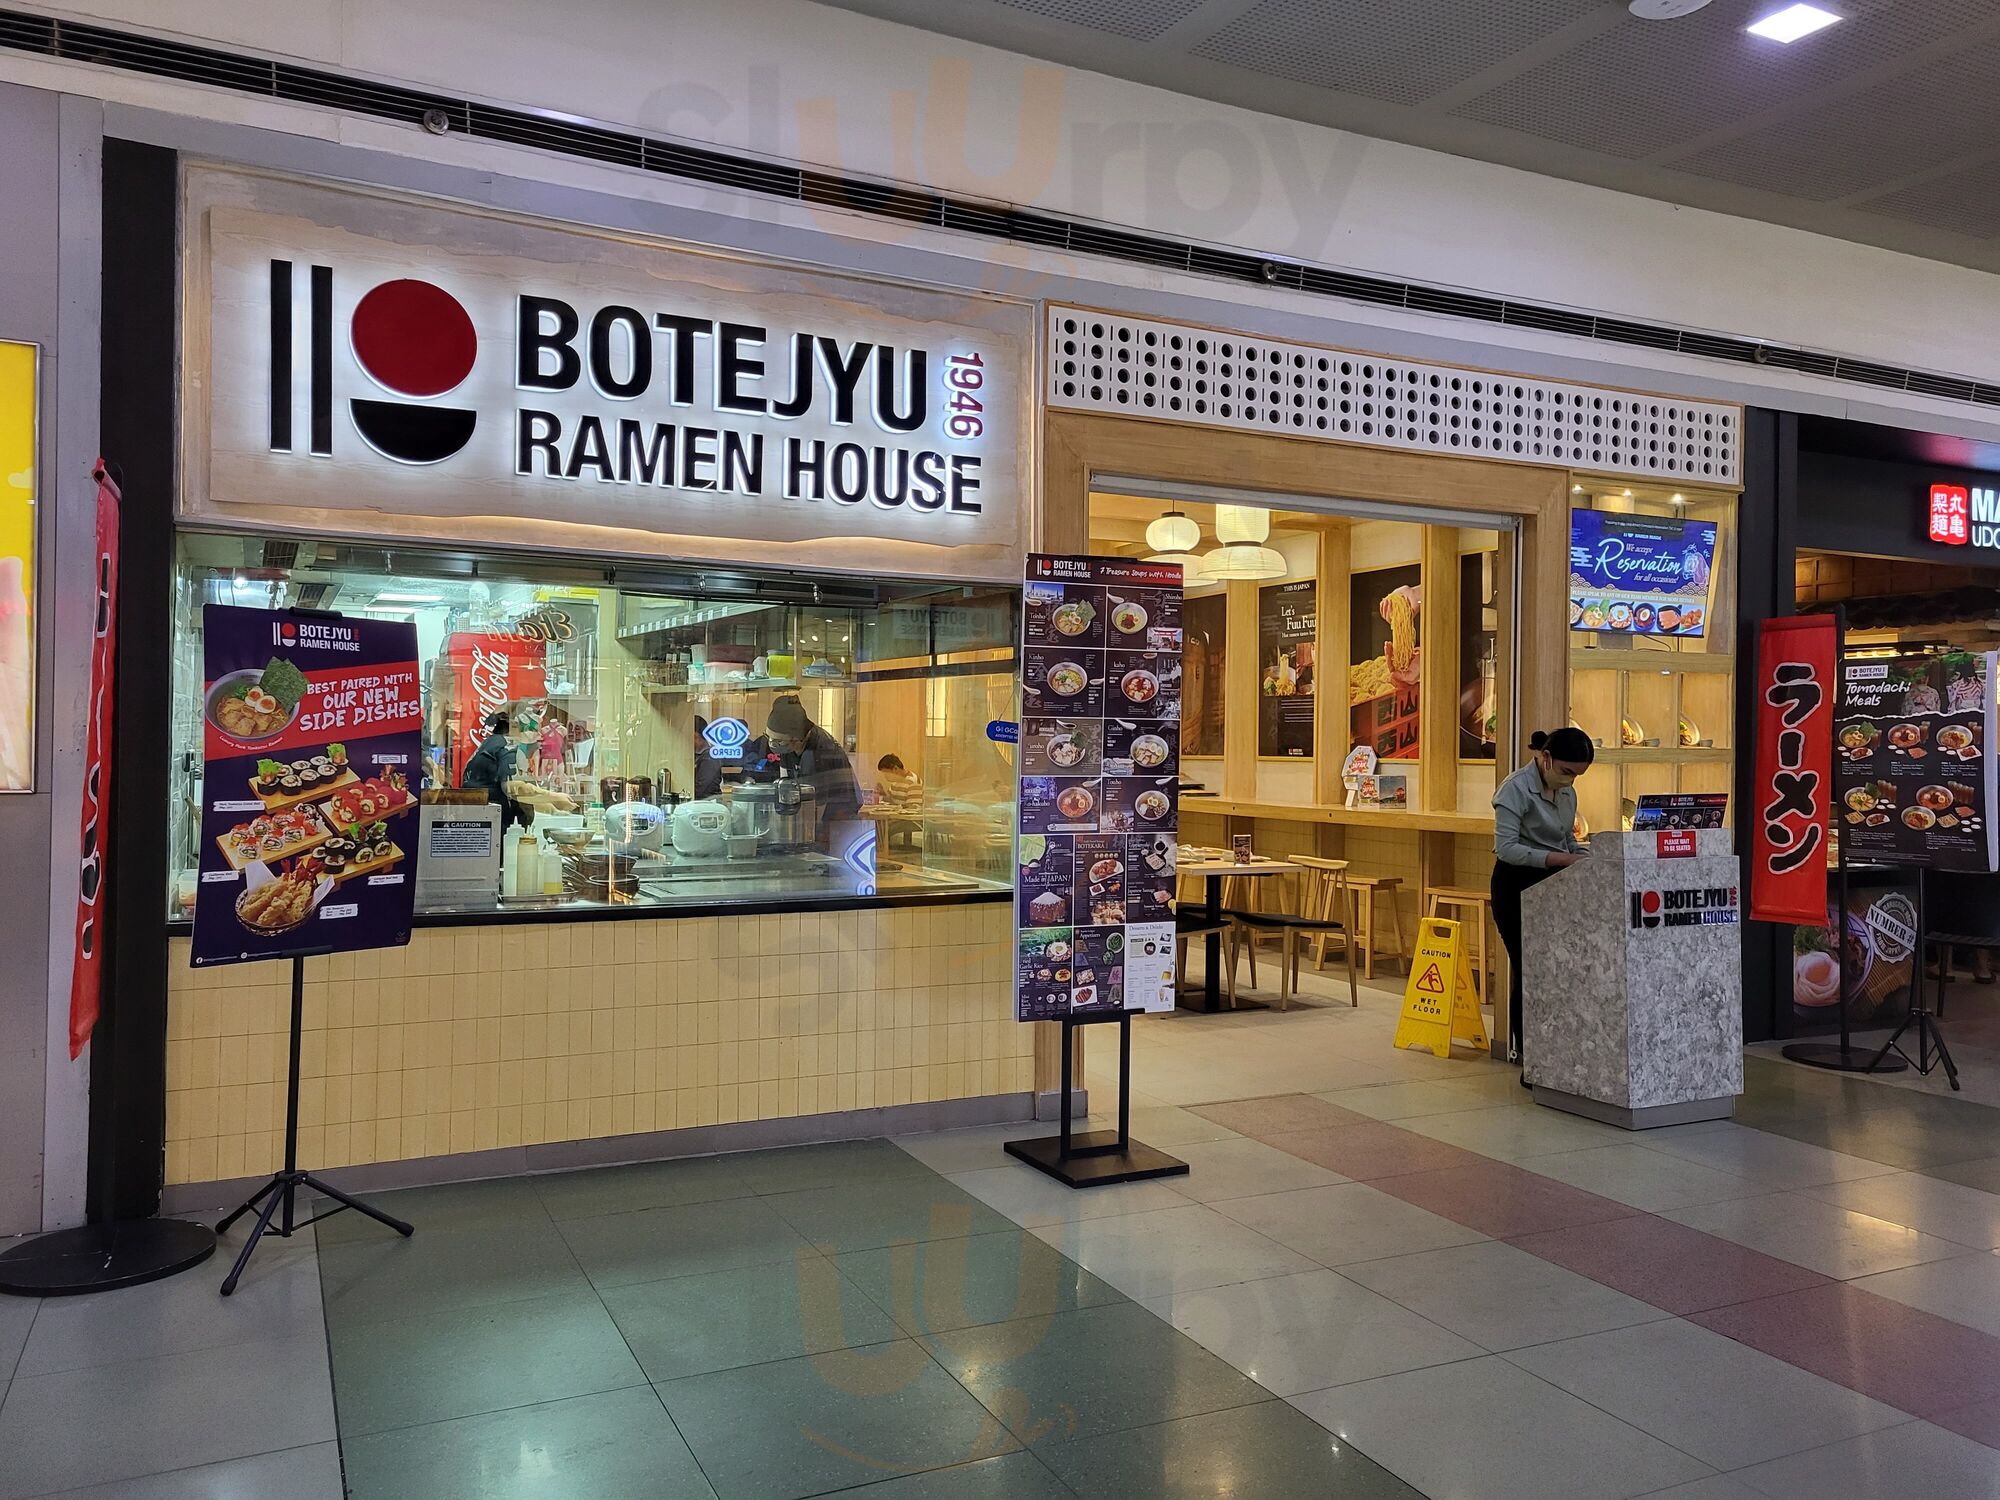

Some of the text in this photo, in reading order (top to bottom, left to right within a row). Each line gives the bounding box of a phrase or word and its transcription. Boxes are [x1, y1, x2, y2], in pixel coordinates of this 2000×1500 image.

[516, 294, 928, 433] BOTEJYU
[944, 352, 985, 440] 1946
[516, 408, 983, 515] RAMEN HOUSE
[1053, 560, 1087, 571] BOTEJYU
[1594, 538, 1683, 580] Reservation
[1053, 569, 1073, 577] RAMEN
[1106, 567, 1130, 576] Treasure
[1131, 569, 1148, 578] Soups
[1149, 569, 1164, 578] with
[1281, 604, 1295, 617] Let's
[1286, 617, 1301, 630] Fuu
[299, 624, 352, 641] BOTEJYU
[300, 638, 361, 652] RAMEN HOUSE
[307, 672, 413, 695] BEST PAIRED WITH
[1845, 681, 1911, 694] Tomodachi
[323, 686, 399, 710] OUR NEW
[1845, 694, 1881, 707] Meals
[300, 700, 420, 731] SIDE DISHES
[1766, 662, 1822, 875] ラーメン
[1663, 887, 1728, 910] BOTEJYU
[1664, 909, 1738, 927] RAMEN HOUSE
[1868, 908, 1907, 941] NUMBER
[1421, 948, 1452, 959] CAUTION
[1412, 1004, 1441, 1015] FLOOR
[1420, 997, 1437, 1006] WET
